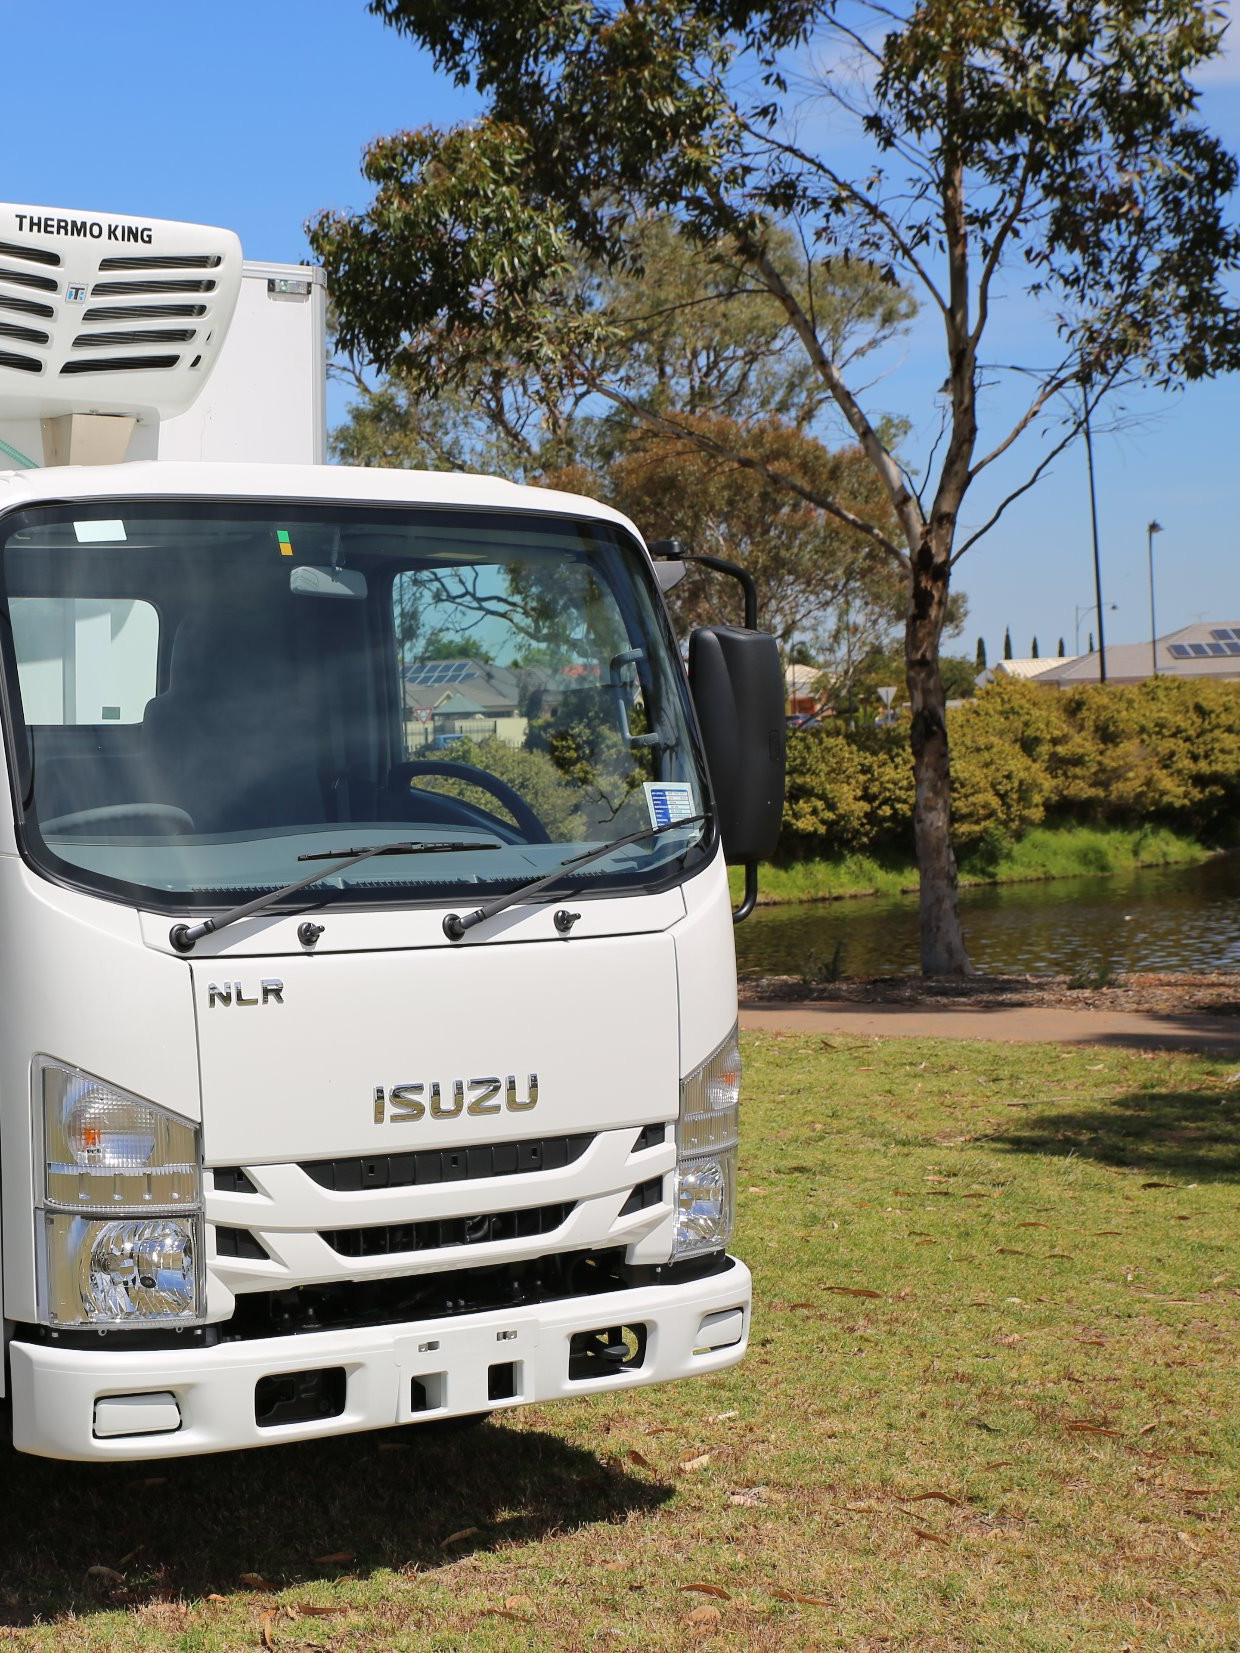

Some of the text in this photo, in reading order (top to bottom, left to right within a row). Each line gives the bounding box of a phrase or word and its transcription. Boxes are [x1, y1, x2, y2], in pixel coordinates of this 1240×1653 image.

[15, 214, 153, 245] THERMO KING
[208, 978, 285, 1008] NLR
[373, 1073, 539, 1125] ISUZU
